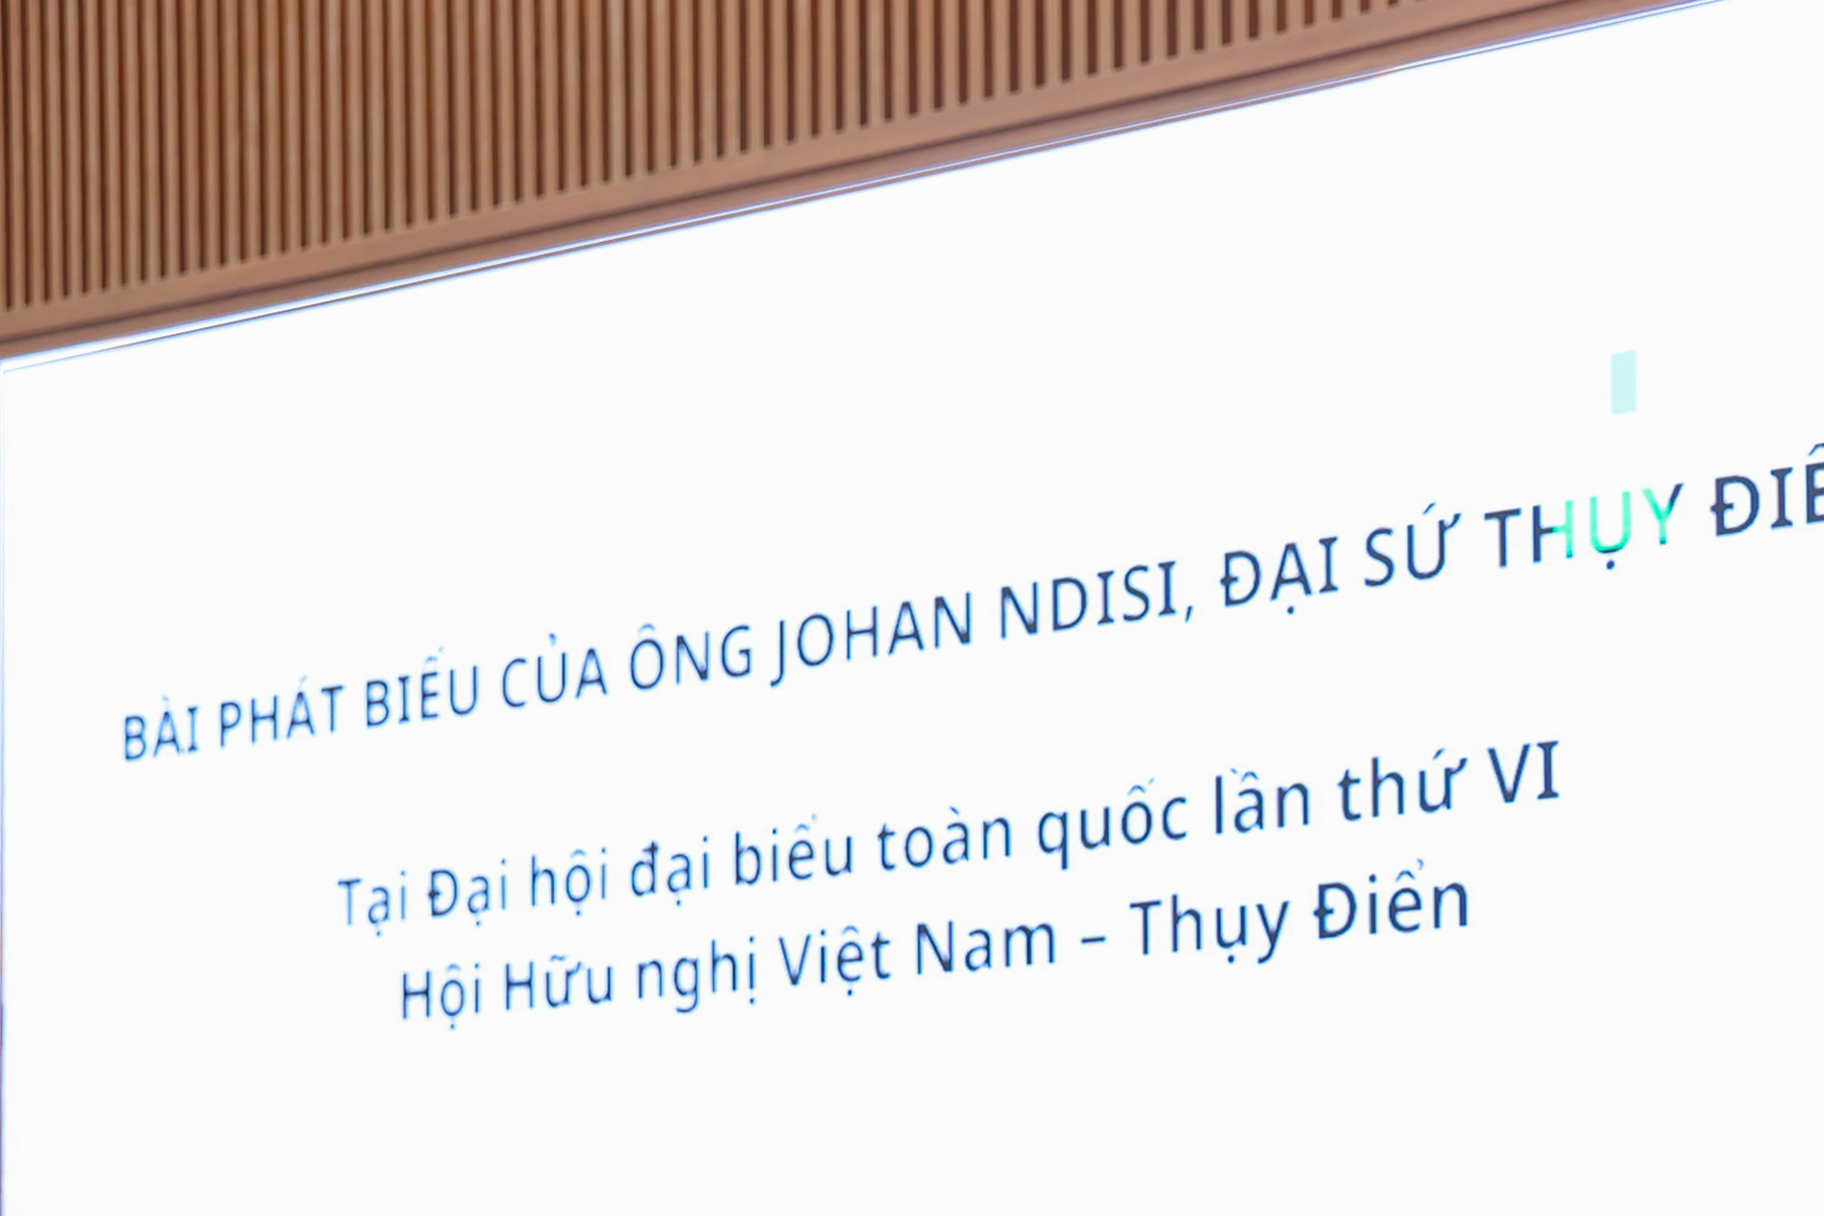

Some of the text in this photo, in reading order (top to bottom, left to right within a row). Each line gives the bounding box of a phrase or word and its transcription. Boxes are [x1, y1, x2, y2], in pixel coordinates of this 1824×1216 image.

[123, 695, 203, 763] BÀI
[219, 676, 346, 750] PHÁT
[501, 632, 609, 710] CỦA
[628, 623, 754, 692] ÔNG
[769, 591, 973, 689] JOHAN
[1000, 559, 1195, 640] NDISI,
[1219, 535, 1340, 616] ĐẠI
[1363, 501, 1463, 588] SỨ
[1483, 482, 1685, 571] THỤY
[337, 870, 407, 938] Tại
[426, 857, 508, 928] Đại
[529, 847, 608, 918] hội
[629, 834, 711, 908] đại
[876, 806, 1013, 872] toàn
[1037, 777, 1188, 872] quốc
[1214, 767, 1311, 836] lần
[1337, 747, 1469, 822] thứ
[1486, 740, 1560, 805] VI
[401, 962, 482, 1031] Hội
[504, 954, 614, 1012] Hữu
[636, 935, 757, 1015] nghị
[777, 925, 892, 997] Việt
[915, 919, 1056, 976] Nam
[1128, 892, 1291, 966] Thụy
[1312, 858, 1469, 941] Điển
